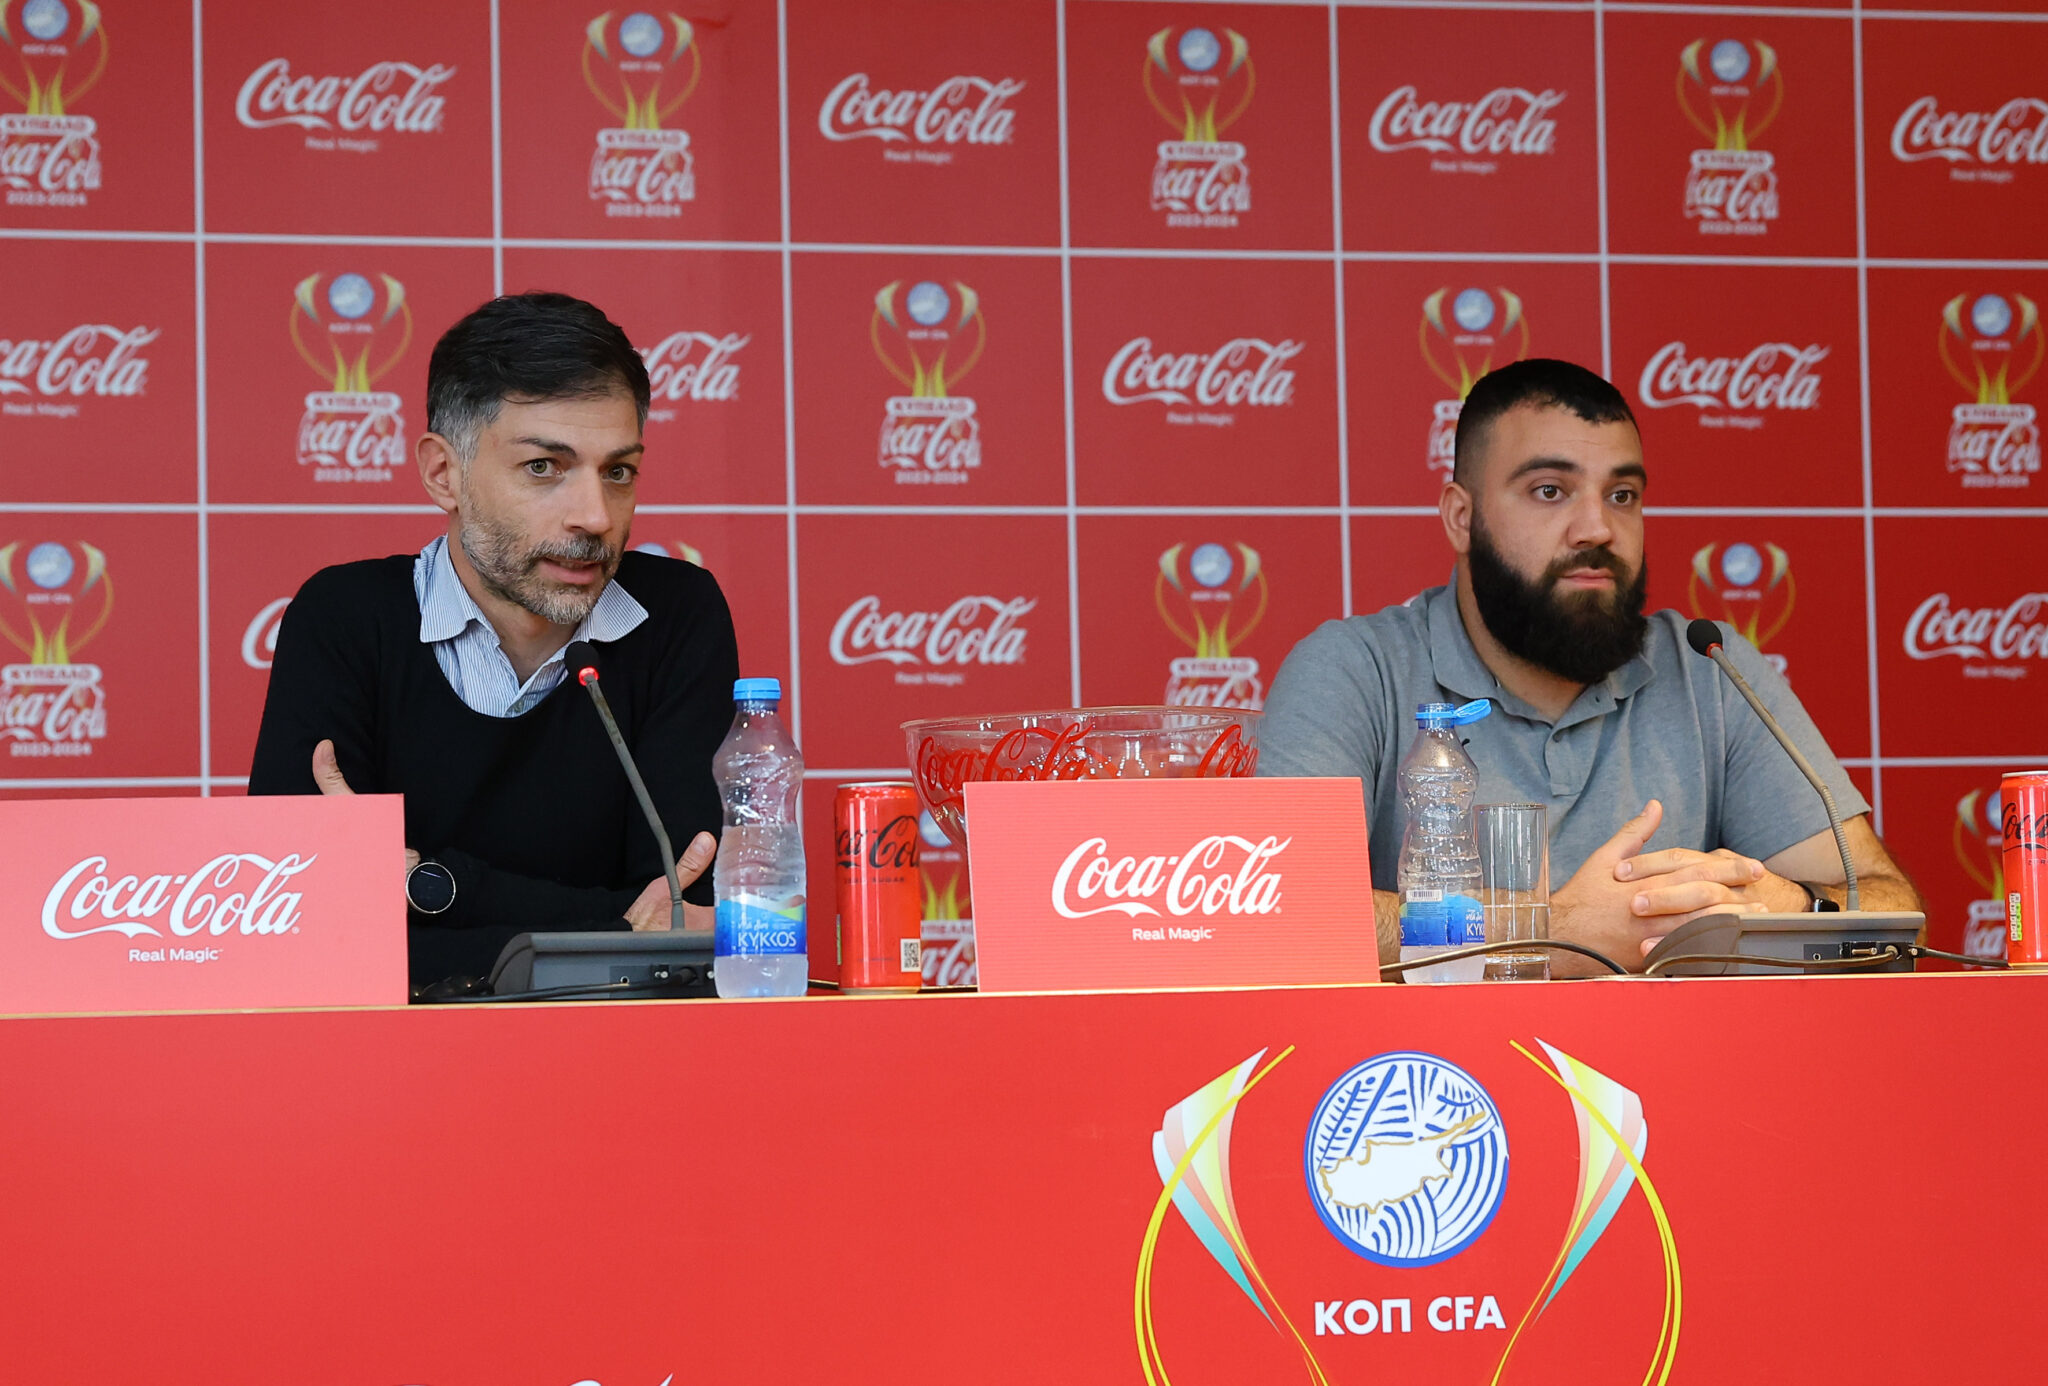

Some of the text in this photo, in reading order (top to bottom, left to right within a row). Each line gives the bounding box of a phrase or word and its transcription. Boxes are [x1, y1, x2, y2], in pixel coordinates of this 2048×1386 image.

[236, 58, 456, 132] Coca-Cola
[819, 73, 1025, 144] Coca-Cola
[1369, 86, 1566, 154] Coca-Cola
[0, 324, 161, 396] ca-Cola
[641, 331, 752, 401] -Cola
[1103, 336, 1305, 406] Coca-Cola
[1639, 341, 1830, 409] Coca-Cola
[830, 595, 1037, 666] Coca-Cola
[1903, 592, 2048, 660] Coca-Co
[41, 853, 319, 940] Coca-Cola
[1051, 835, 1293, 919] Coca-Cola
[129, 947, 220, 963] Real Magic
[1132, 926, 1213, 942] Real Magic
[1427, 1295, 1507, 1332] CFA
